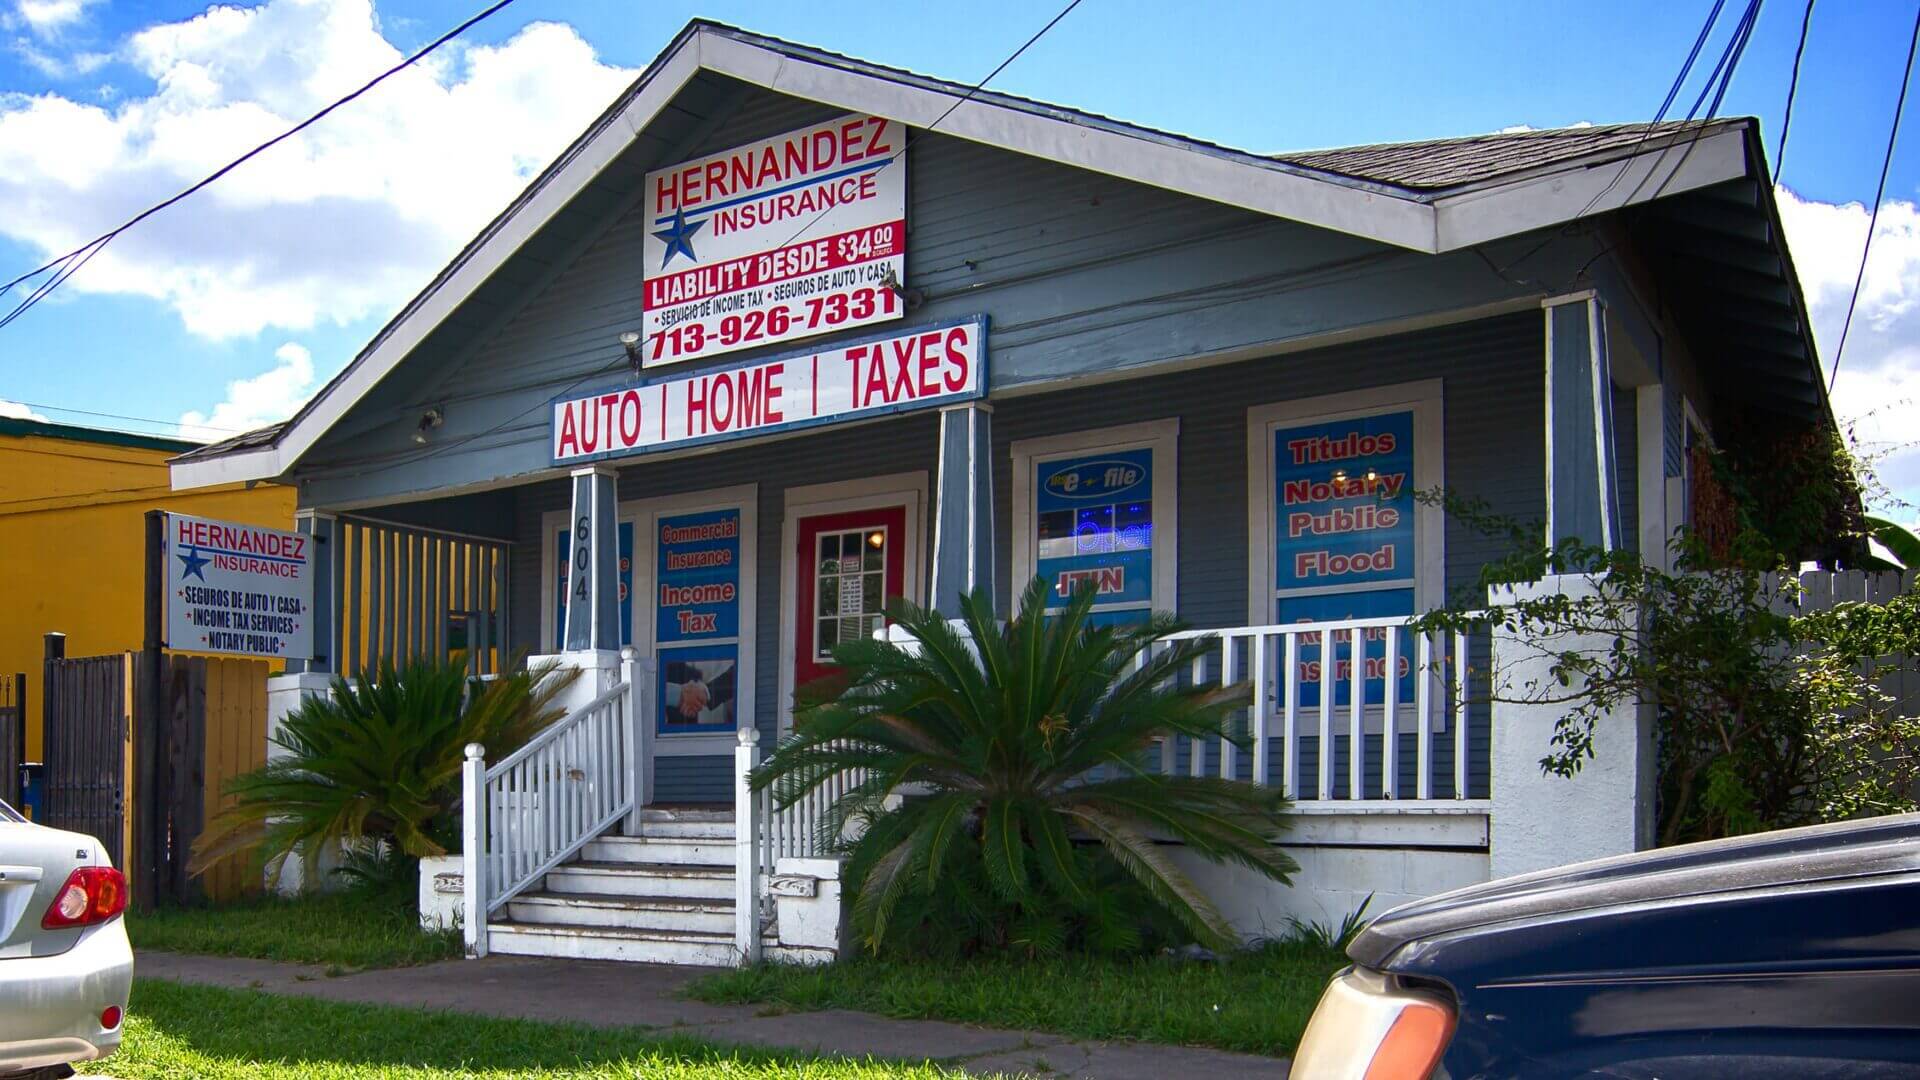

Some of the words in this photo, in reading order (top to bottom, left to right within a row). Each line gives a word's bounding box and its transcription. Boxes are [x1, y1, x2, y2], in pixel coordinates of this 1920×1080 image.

[656, 117, 891, 214] HERNANDEZ
[713, 172, 877, 237] INSURANCE
[652, 257, 752, 308] LIABILITY
[757, 240, 829, 283] DESDE
[661, 305, 699, 326] SERVICIO
[700, 298, 711, 317] DE
[713, 293, 745, 315] INCOME
[747, 289, 764, 306] TAX
[774, 278, 815, 302] SEGUROS
[818, 274, 829, 291] DE
[832, 268, 856, 290] AUTO
[859, 266, 865, 284] Y
[867, 261, 892, 281] CASA
[650, 287, 896, 361] 713-926-7331
[557, 390, 641, 458] AUTO
[686, 363, 784, 437] HOME
[845, 326, 969, 409] TAXES
[1288, 432, 1396, 465] Titulos
[1284, 472, 1406, 505] Notary
[662, 517, 738, 545] Commercial
[1289, 504, 1400, 538] Public
[178, 520, 306, 560] HERNANDEZ
[213, 554, 299, 579] INSURANCE
[576, 516, 589, 601] 604
[667, 548, 732, 571] Insurance
[1295, 544, 1396, 579] Flood
[184, 585, 229, 609] SEGUROS
[231, 591, 243, 609] DE
[244, 594, 268, 612] AUTO
[269, 596, 277, 613] Y
[278, 598, 301, 615] CASA
[661, 582, 736, 607] Income
[193, 608, 231, 629] INCOME
[233, 612, 249, 630] TAX
[251, 615, 294, 634] SERVICES
[677, 610, 718, 634] Tax
[208, 631, 245, 651] NOTARY
[246, 635, 280, 654] PUBLIC
